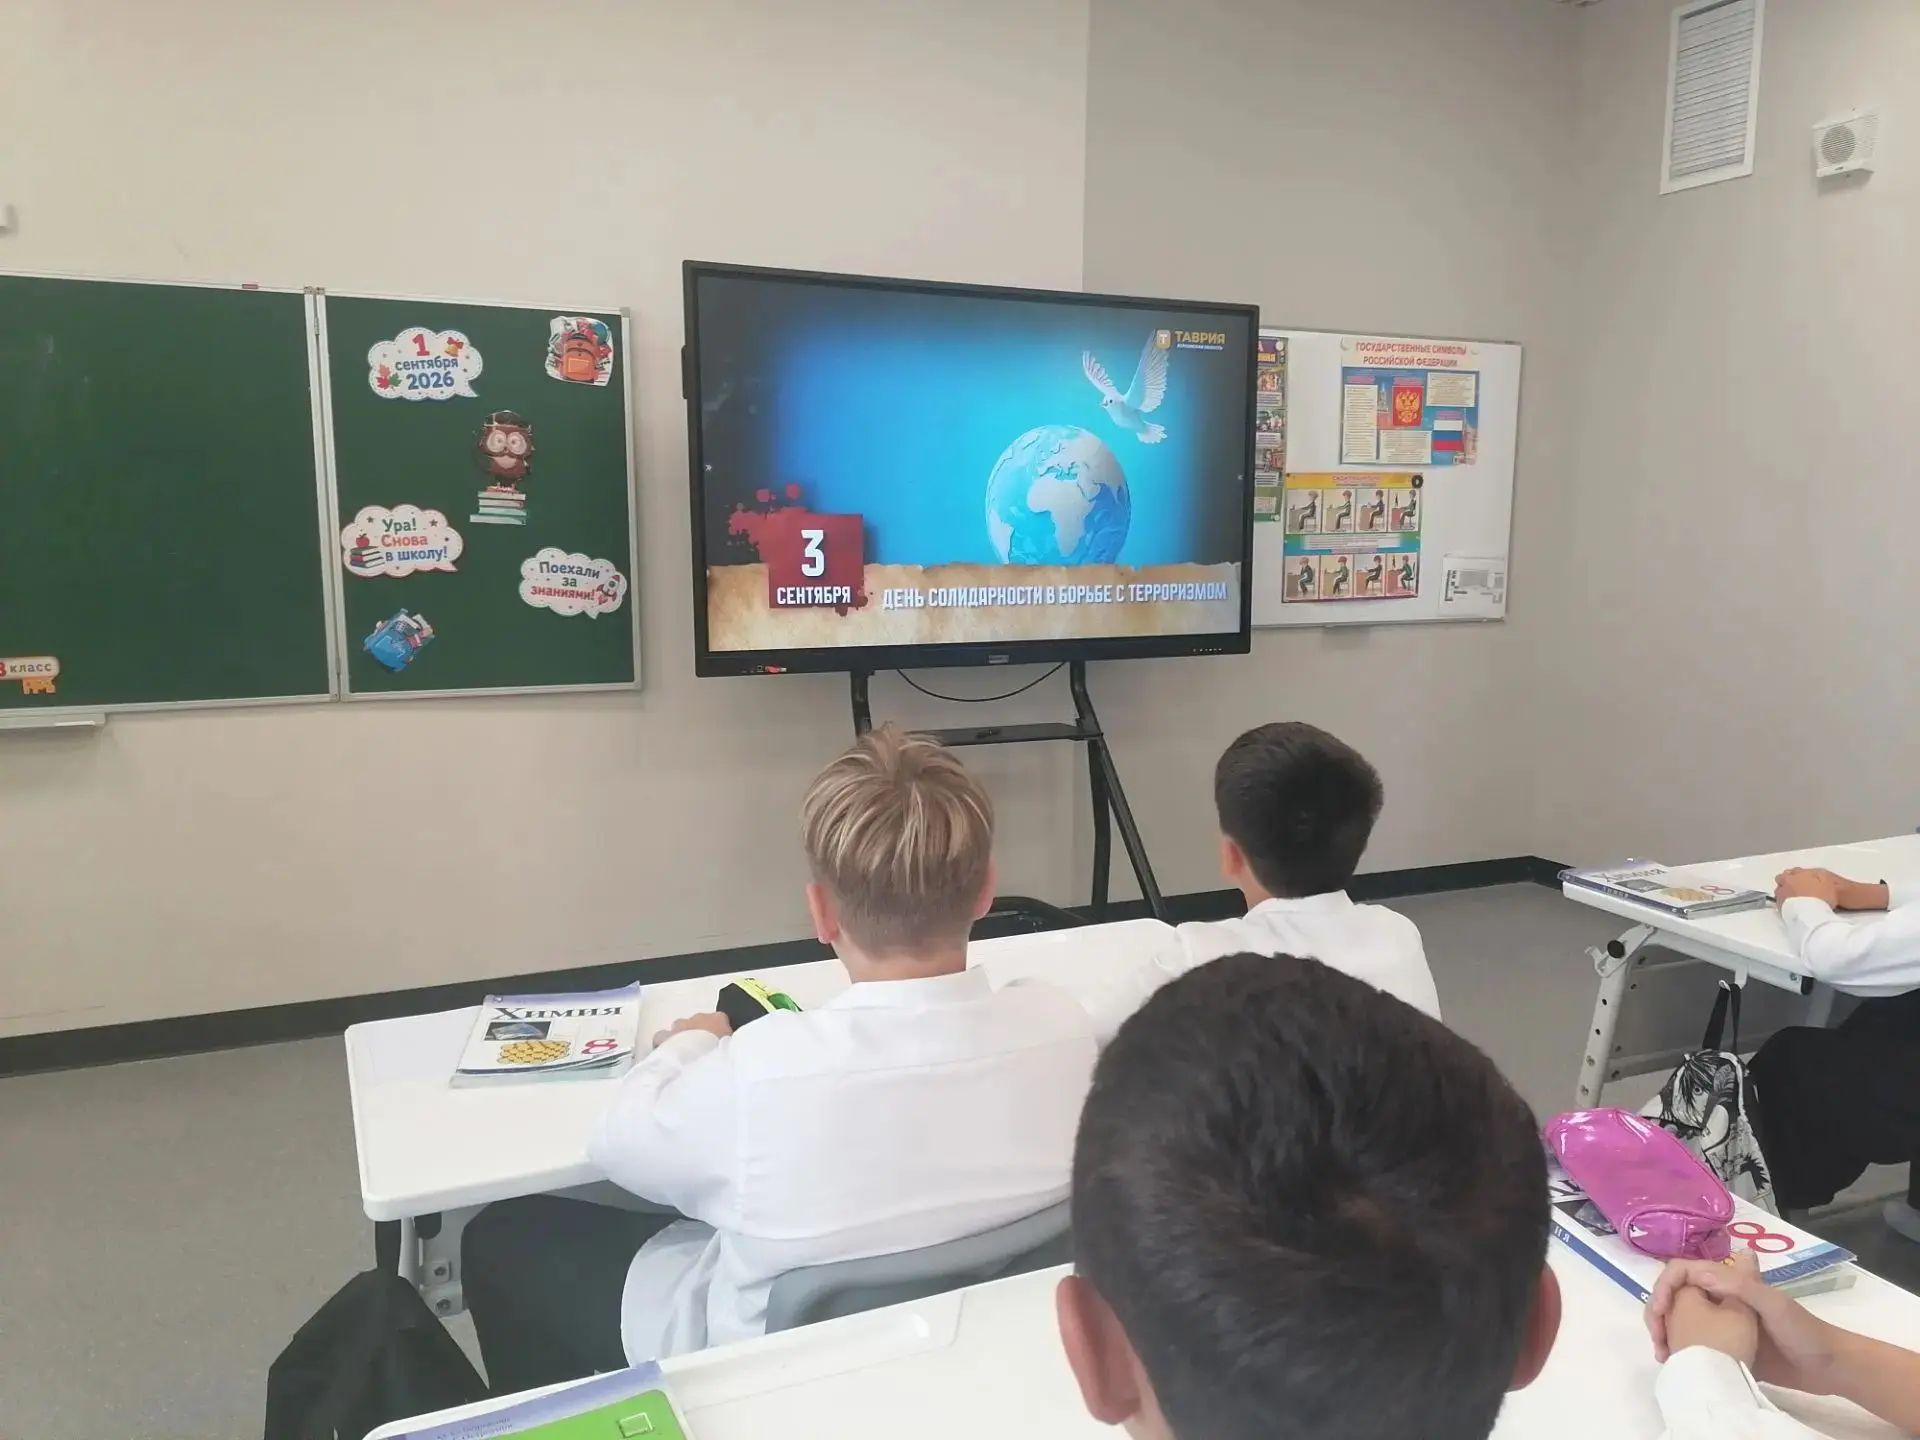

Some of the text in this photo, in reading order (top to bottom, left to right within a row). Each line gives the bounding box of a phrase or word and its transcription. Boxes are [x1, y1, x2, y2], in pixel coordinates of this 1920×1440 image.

[412, 333, 430, 356] 1
[1174, 331, 1226, 345] ТАВРИЯ
[1355, 342, 1432, 354] ГОСУДАРСТВЕННЫЕ
[395, 355, 459, 372] сентября
[1363, 355, 1415, 366] РОССИЙСКОЙ
[406, 370, 455, 390] 2026
[382, 517, 416, 536] Ура!
[381, 534, 428, 548] Снова
[385, 546, 448, 563] в школу!
[801, 529, 825, 577] 3
[539, 561, 601, 579] Поехали
[562, 577, 578, 588] за
[530, 586, 596, 602] знаниями!
[776, 585, 851, 605] СЕНТЯБРЯ
[883, 581, 1228, 609] ДЕНЬ СОЛИДАРНОСТИ В БОРЬБЕ С ТЕРРОРИЗМОМ
[9, 663, 52, 674] класс
[494, 1006, 624, 1021] Химия
[580, 1038, 618, 1055] 8
[1727, 1221, 1796, 1254] 8
